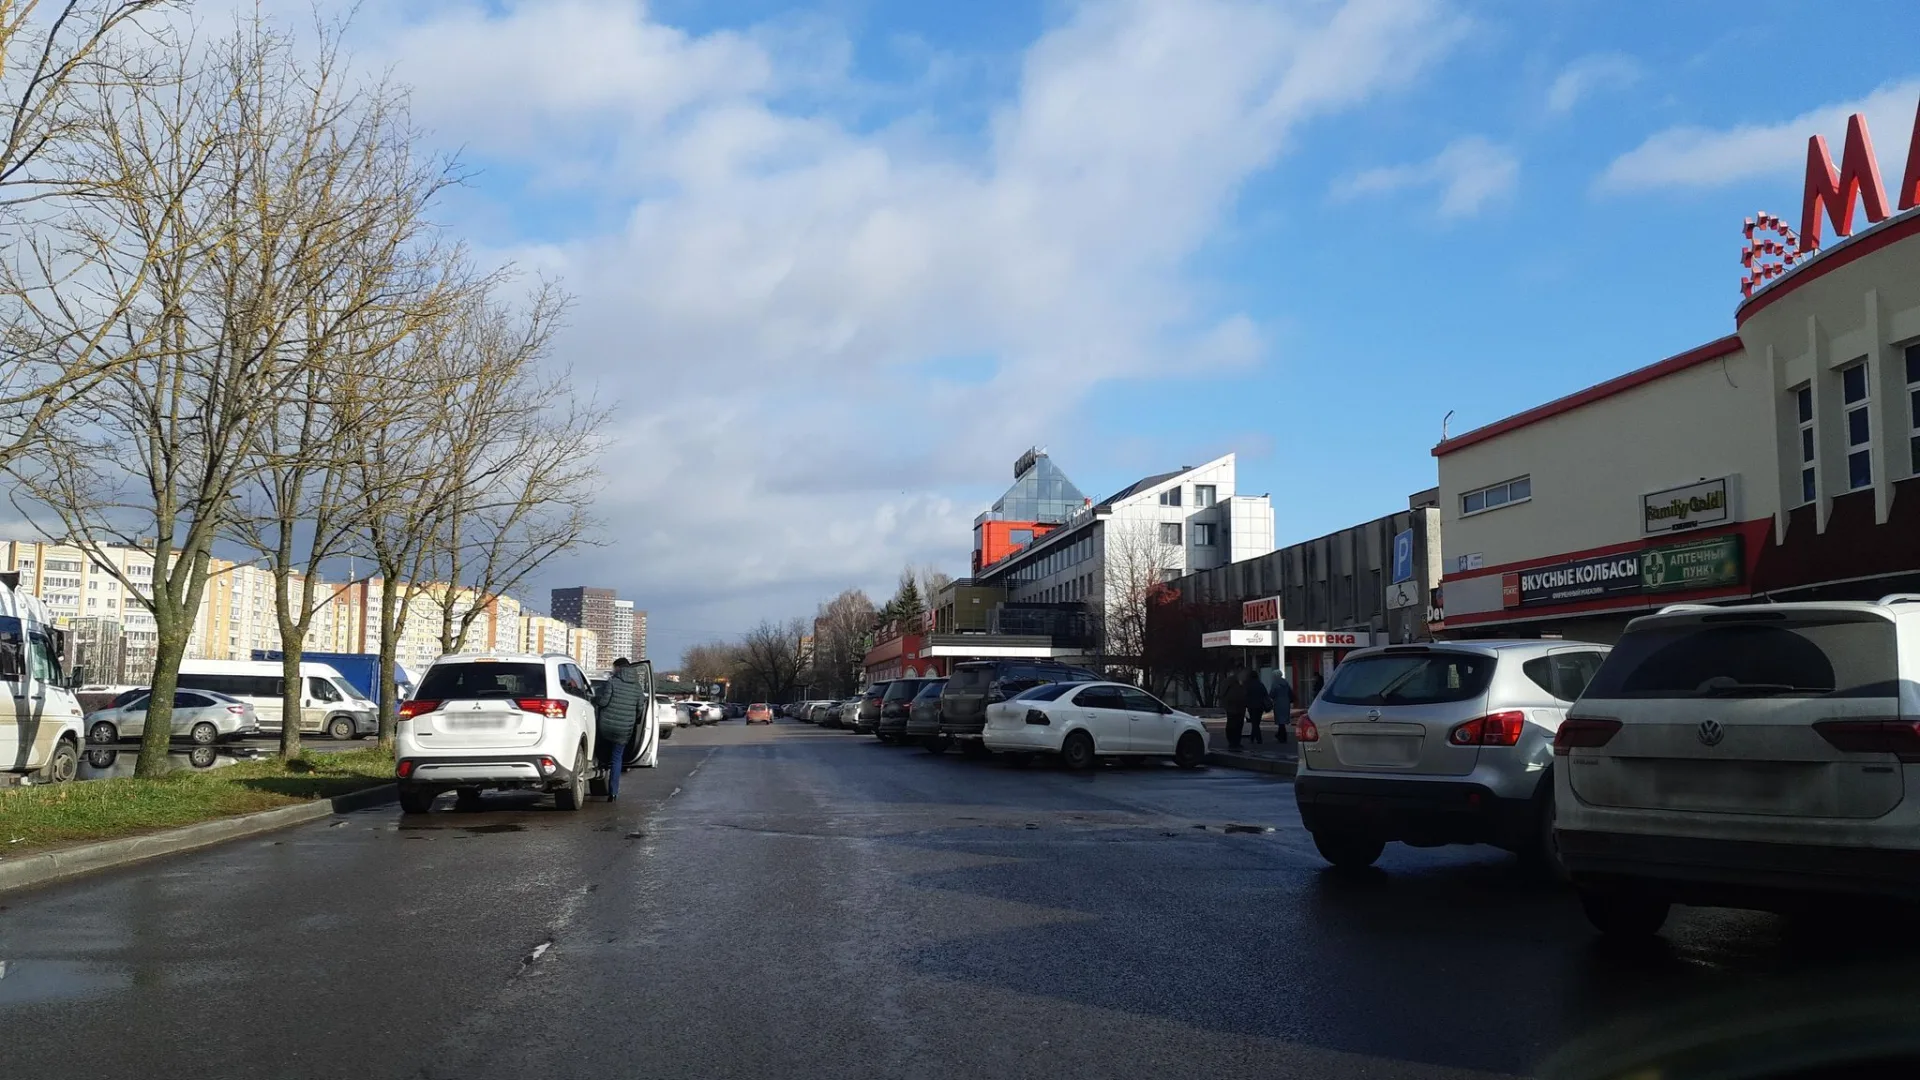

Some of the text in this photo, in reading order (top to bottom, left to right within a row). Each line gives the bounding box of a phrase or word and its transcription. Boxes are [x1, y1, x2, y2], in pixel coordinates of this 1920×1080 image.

[1689, 491, 1723, 512] Gold
[1397, 537, 1409, 576] P
[1521, 558, 1639, 592] ВКУСНЫЕ КОЛБАСЫ
[1243, 599, 1278, 624] АПТЕКА
[1297, 634, 1356, 644] аптека
